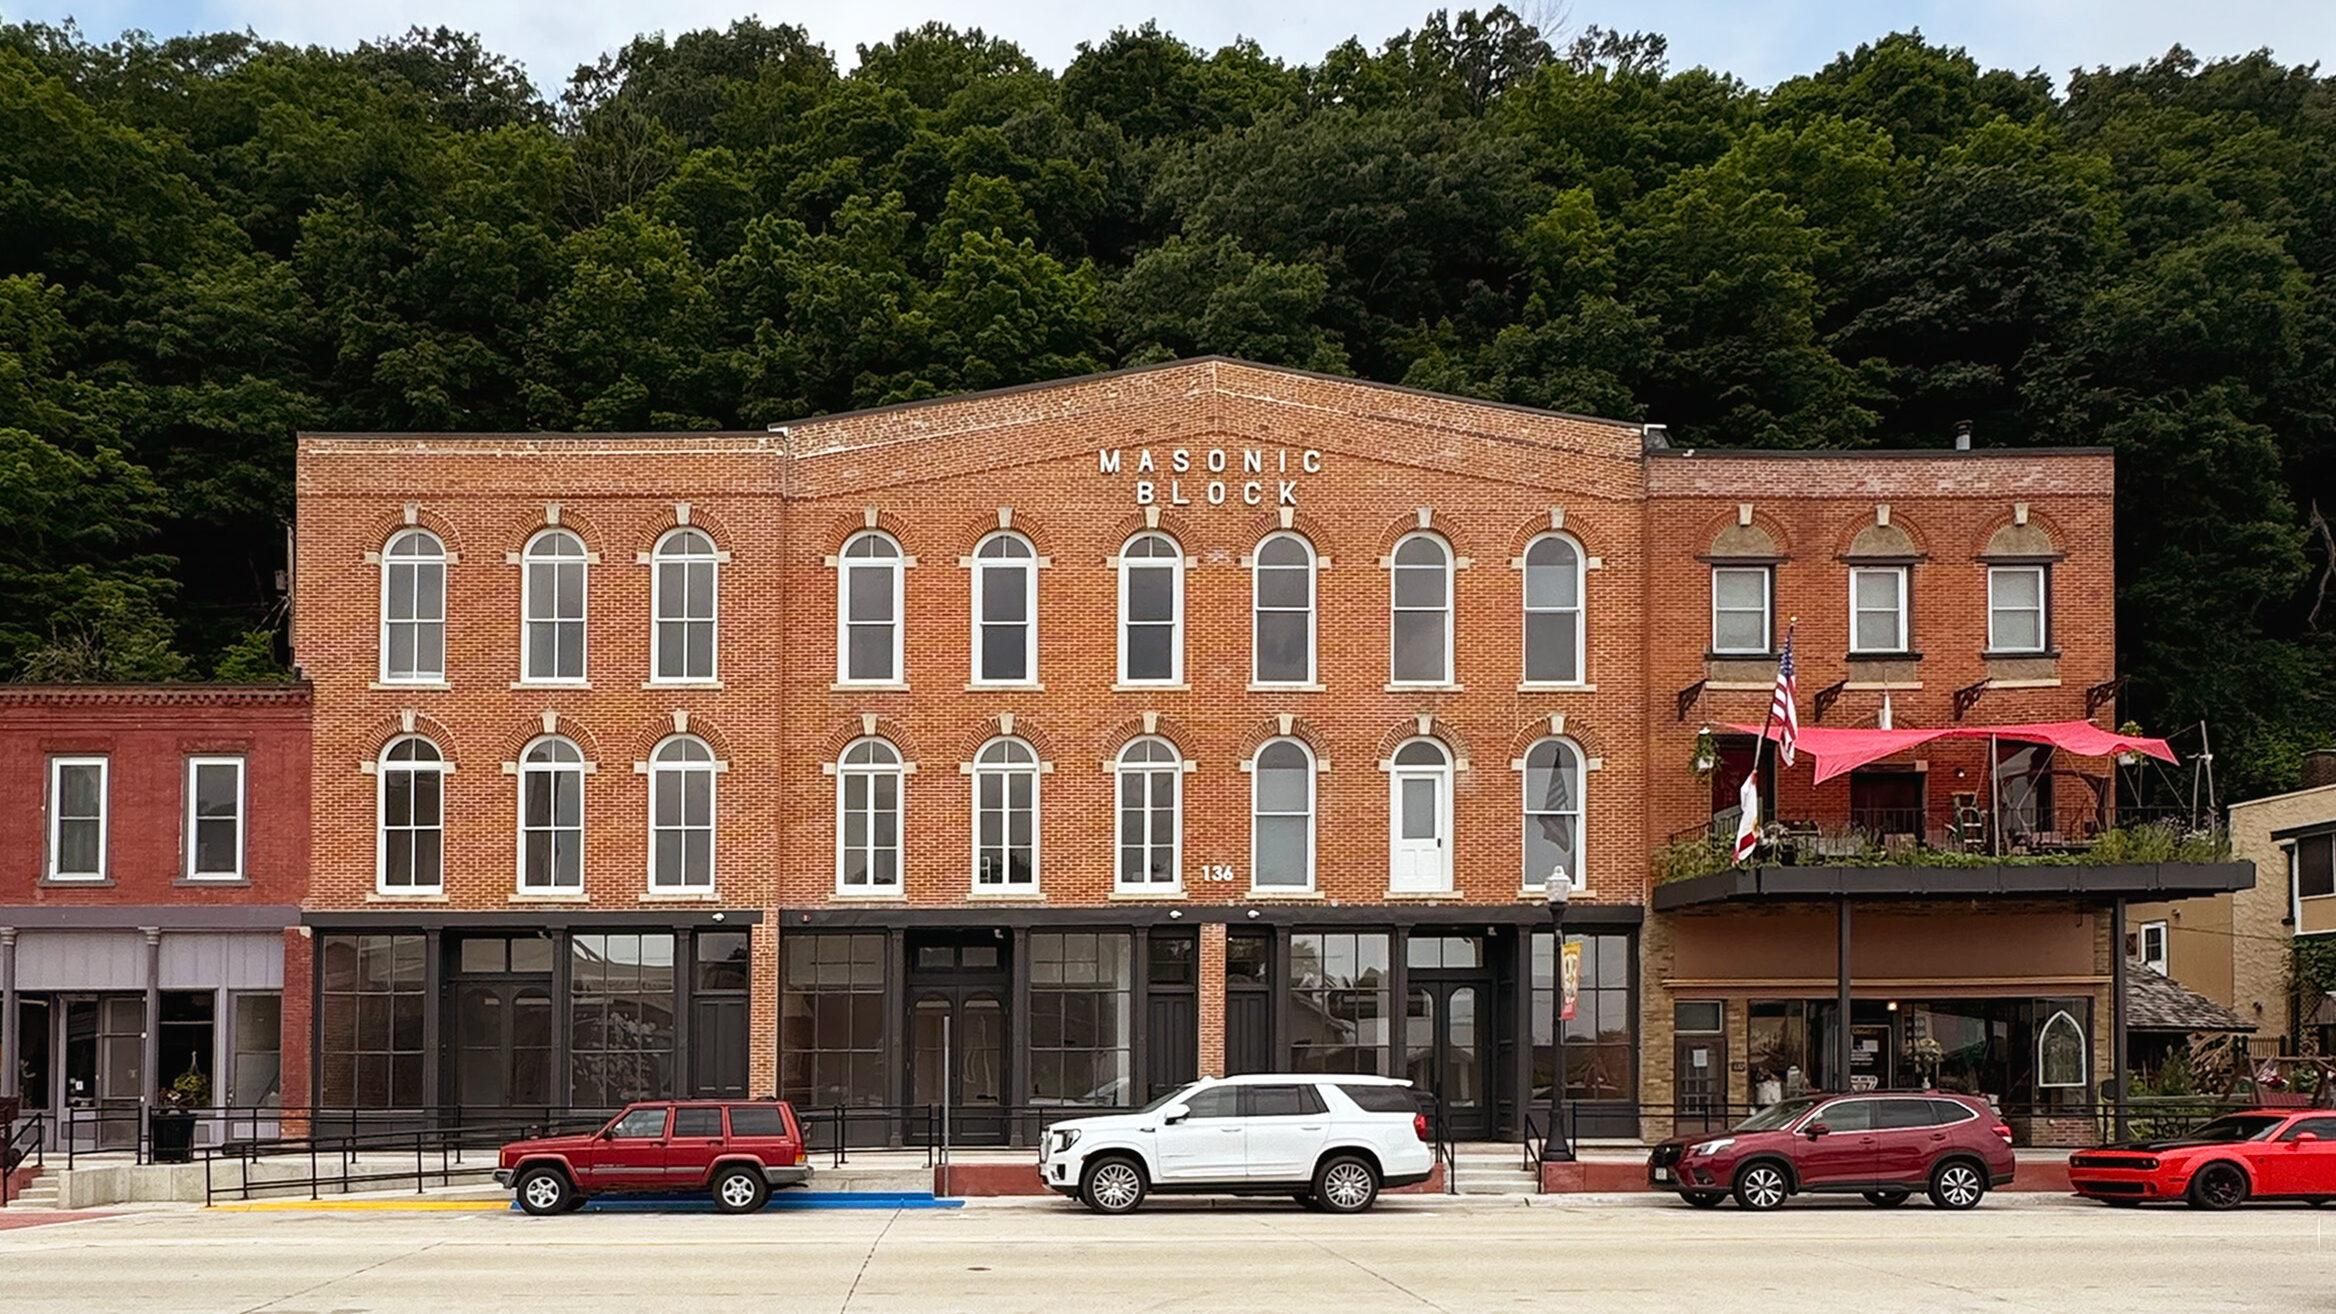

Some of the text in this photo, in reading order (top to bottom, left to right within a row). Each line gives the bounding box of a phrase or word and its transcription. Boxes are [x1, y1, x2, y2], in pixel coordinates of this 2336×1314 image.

[1100, 448, 1321, 473] MASONIC
[1137, 480, 1297, 505] BLOCK
[1201, 865, 1234, 881] 136
